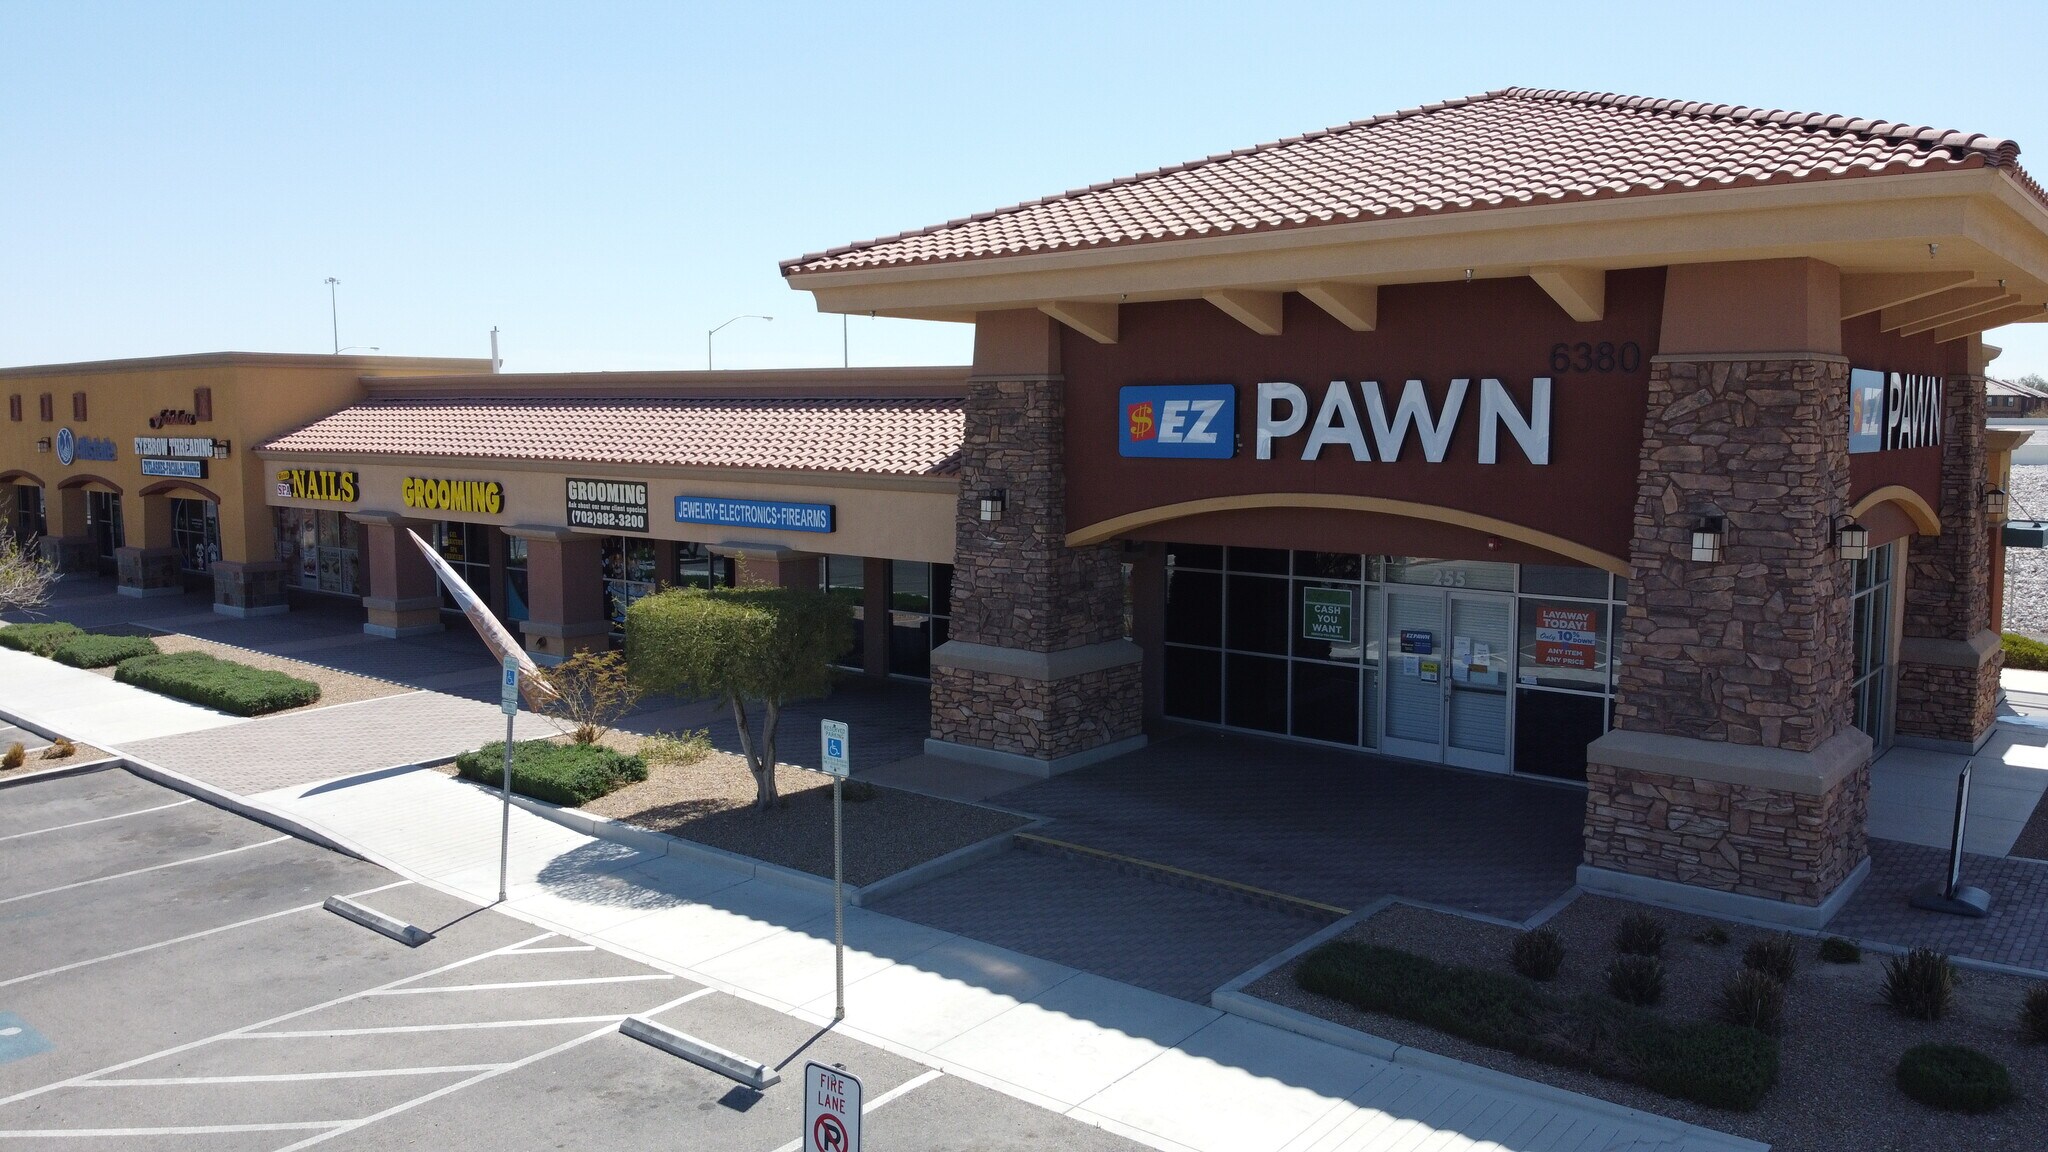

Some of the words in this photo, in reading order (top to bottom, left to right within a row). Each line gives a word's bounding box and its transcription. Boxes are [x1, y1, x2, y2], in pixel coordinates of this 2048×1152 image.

[1550, 342, 1640, 374] 6380
[1861, 387, 1882, 435] EZ
[1887, 372, 1943, 450] PAWN
[1256, 378, 1551, 465] PAWN
[134, 437, 168, 456] EYEBROW
[168, 438, 214, 458] THREADING
[277, 484, 291, 497] SPA
[291, 469, 355, 503] NAILS
[568, 481, 646, 505] GROOMING
[402, 477, 501, 515] GROOMING
[568, 501, 577, 509] Ask
[578, 502, 591, 510] about
[612, 504, 626, 513] client
[627, 506, 647, 514] specials
[1432, 569, 1466, 587] 255
[1314, 604, 1341, 615] CASH
[1543, 610, 1589, 621] LAYAWAY
[1317, 614, 1338, 624] YOU
[1543, 619, 1588, 631] TODAY!
[1312, 623, 1342, 634] WANT
[1540, 632, 1556, 641] Only
[1562, 658, 1585, 666] PRICE
[820, 1073, 844, 1095] FIRE
[817, 1091, 846, 1115] LANE
